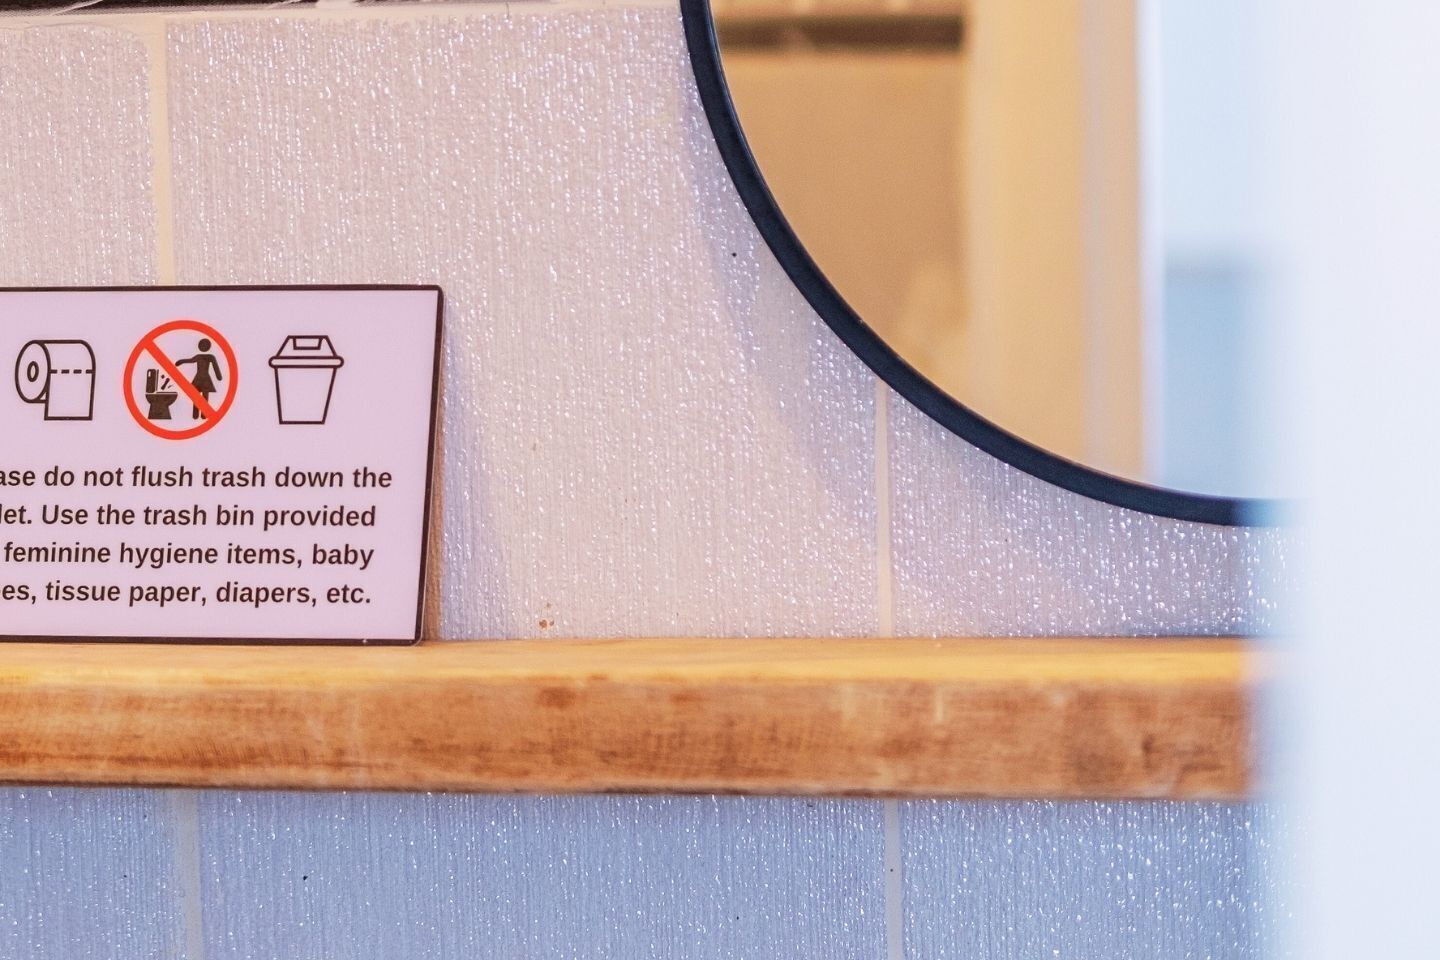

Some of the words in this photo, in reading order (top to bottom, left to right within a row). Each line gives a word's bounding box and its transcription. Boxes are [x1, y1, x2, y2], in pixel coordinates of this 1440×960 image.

[44, 466, 75, 486] do
[84, 467, 123, 487] not
[132, 465, 193, 487] flush
[202, 466, 266, 487] trash
[275, 466, 344, 487] down
[353, 467, 393, 487] the
[42, 504, 89, 525] Use
[97, 504, 135, 525] the
[144, 504, 207, 525] trash
[217, 504, 254, 526] bin
[264, 505, 376, 531] provided
[4, 541, 111, 563] feminine
[120, 542, 219, 569] hygiene
[227, 542, 303, 569] items,
[312, 543, 375, 570] baby
[46, 580, 121, 601] tissue
[129, 586, 207, 607] paper,
[217, 581, 317, 608] diapers,
[326, 584, 371, 604] etc.
